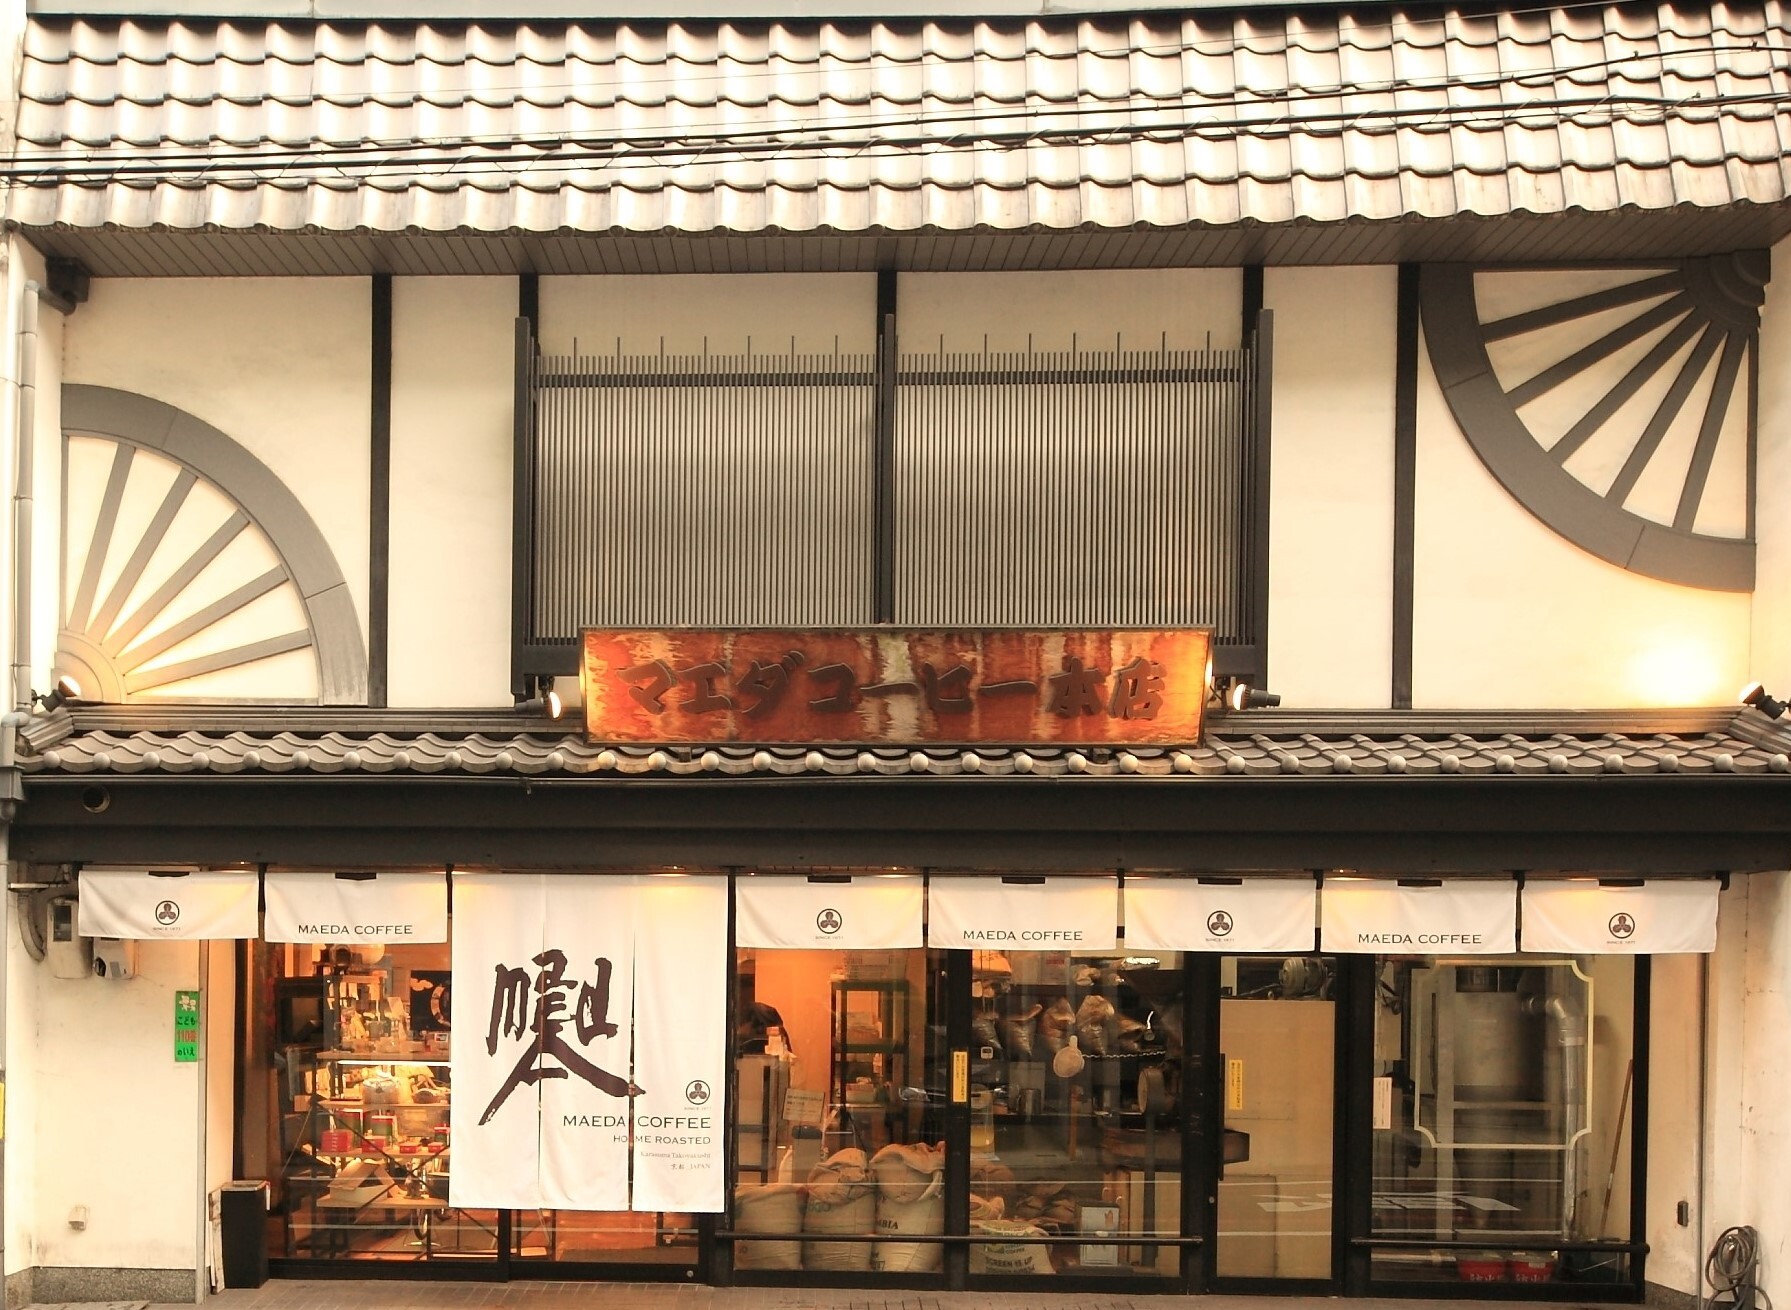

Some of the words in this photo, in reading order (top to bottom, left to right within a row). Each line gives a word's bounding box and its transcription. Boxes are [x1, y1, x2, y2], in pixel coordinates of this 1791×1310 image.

[616, 650, 1168, 720] マエダコーヒー本店
[298, 924, 350, 935] MAEDA
[354, 924, 413, 935] COFFEE
[963, 930, 1017, 940] MAEDA
[1021, 930, 1083, 941] COFFEE
[1358, 933, 1413, 944] MAEDA
[1418, 933, 1482, 944] COFFEE
[563, 1115, 626, 1127] MAEDA
[637, 1116, 711, 1129] COFFEE
[614, 1135, 651, 1144] HOME
[655, 1136, 711, 1145] ROASTED
